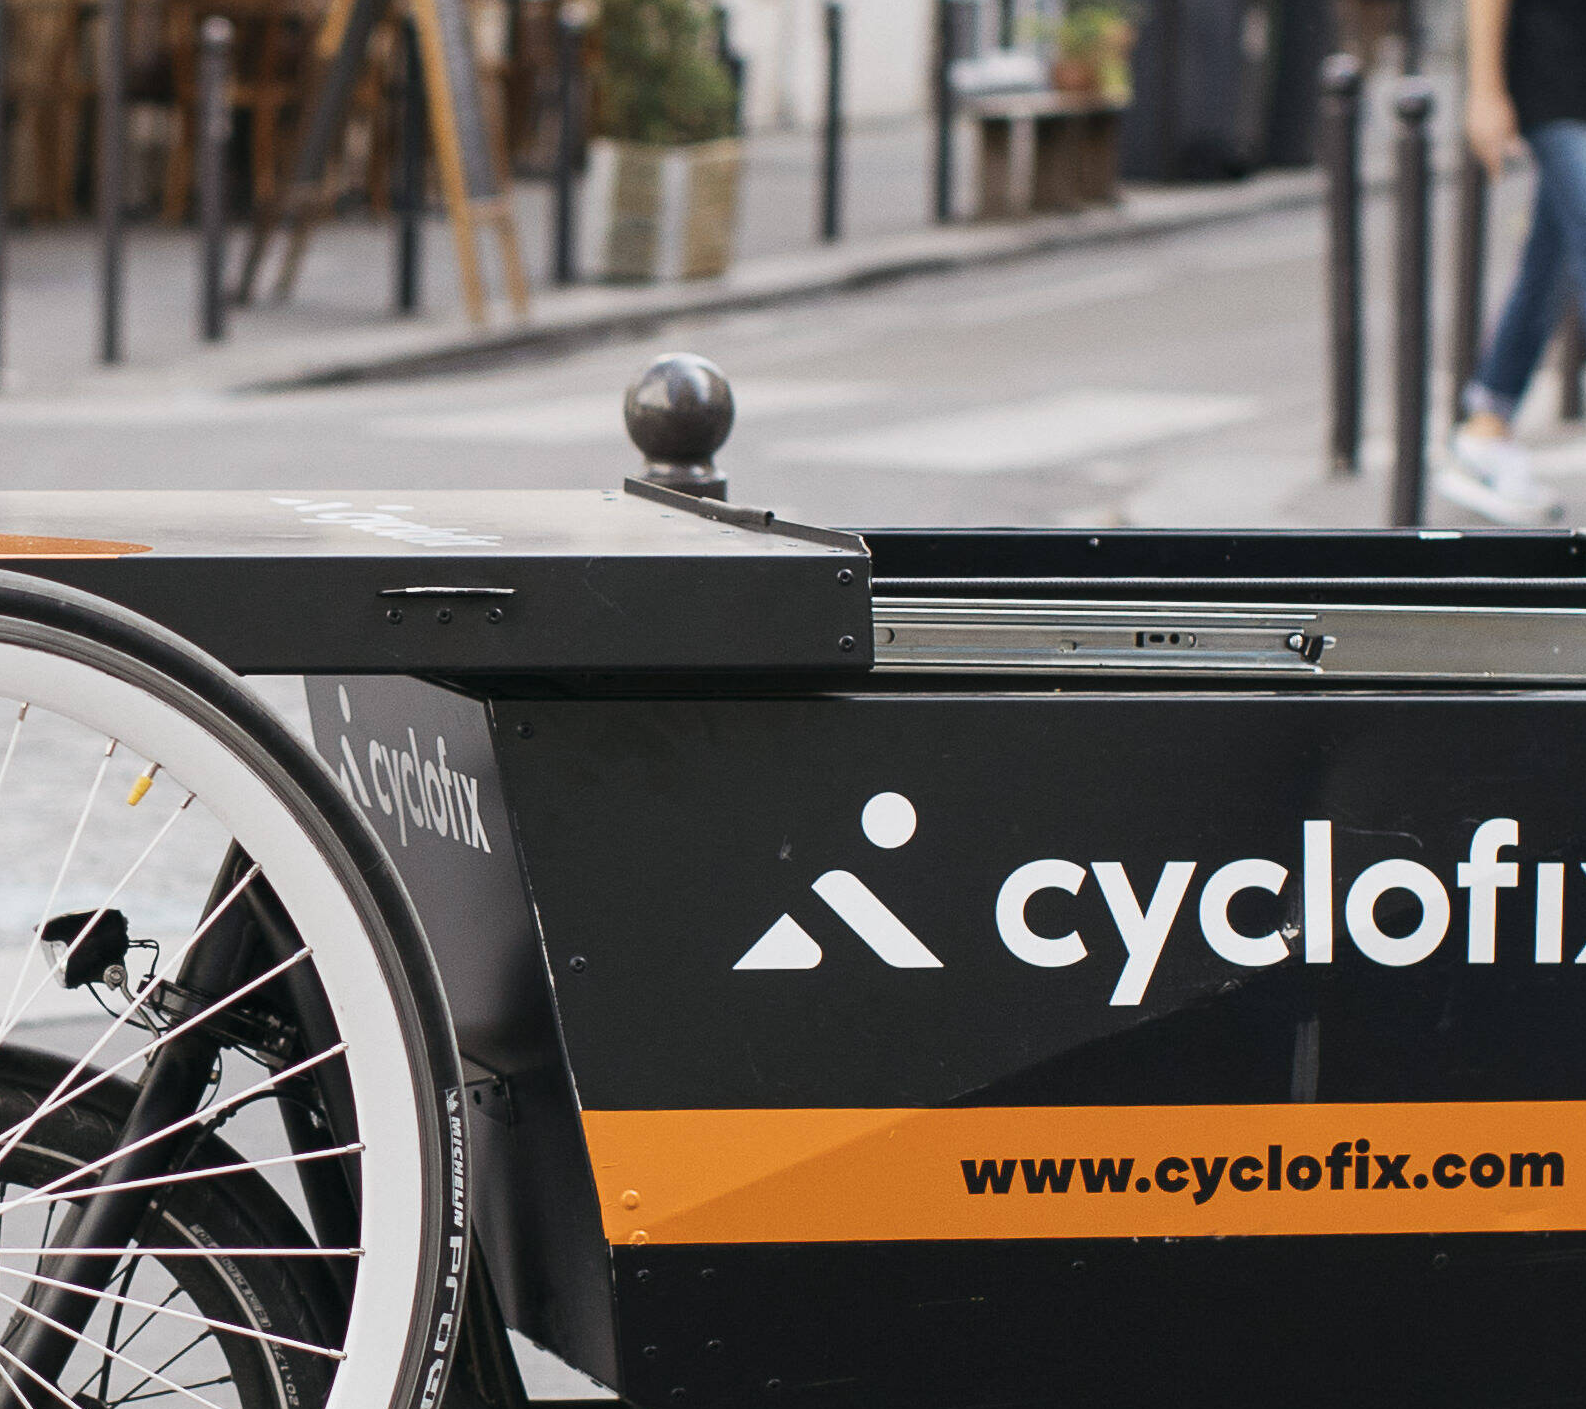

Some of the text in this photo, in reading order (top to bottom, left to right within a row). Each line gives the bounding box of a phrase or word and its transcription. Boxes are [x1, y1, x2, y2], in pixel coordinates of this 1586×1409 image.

[367, 724, 492, 855] cyclofix
[449, 1116, 465, 1228] MICHELIN
[959, 1138, 1566, 1206] www.cyclofix.com
